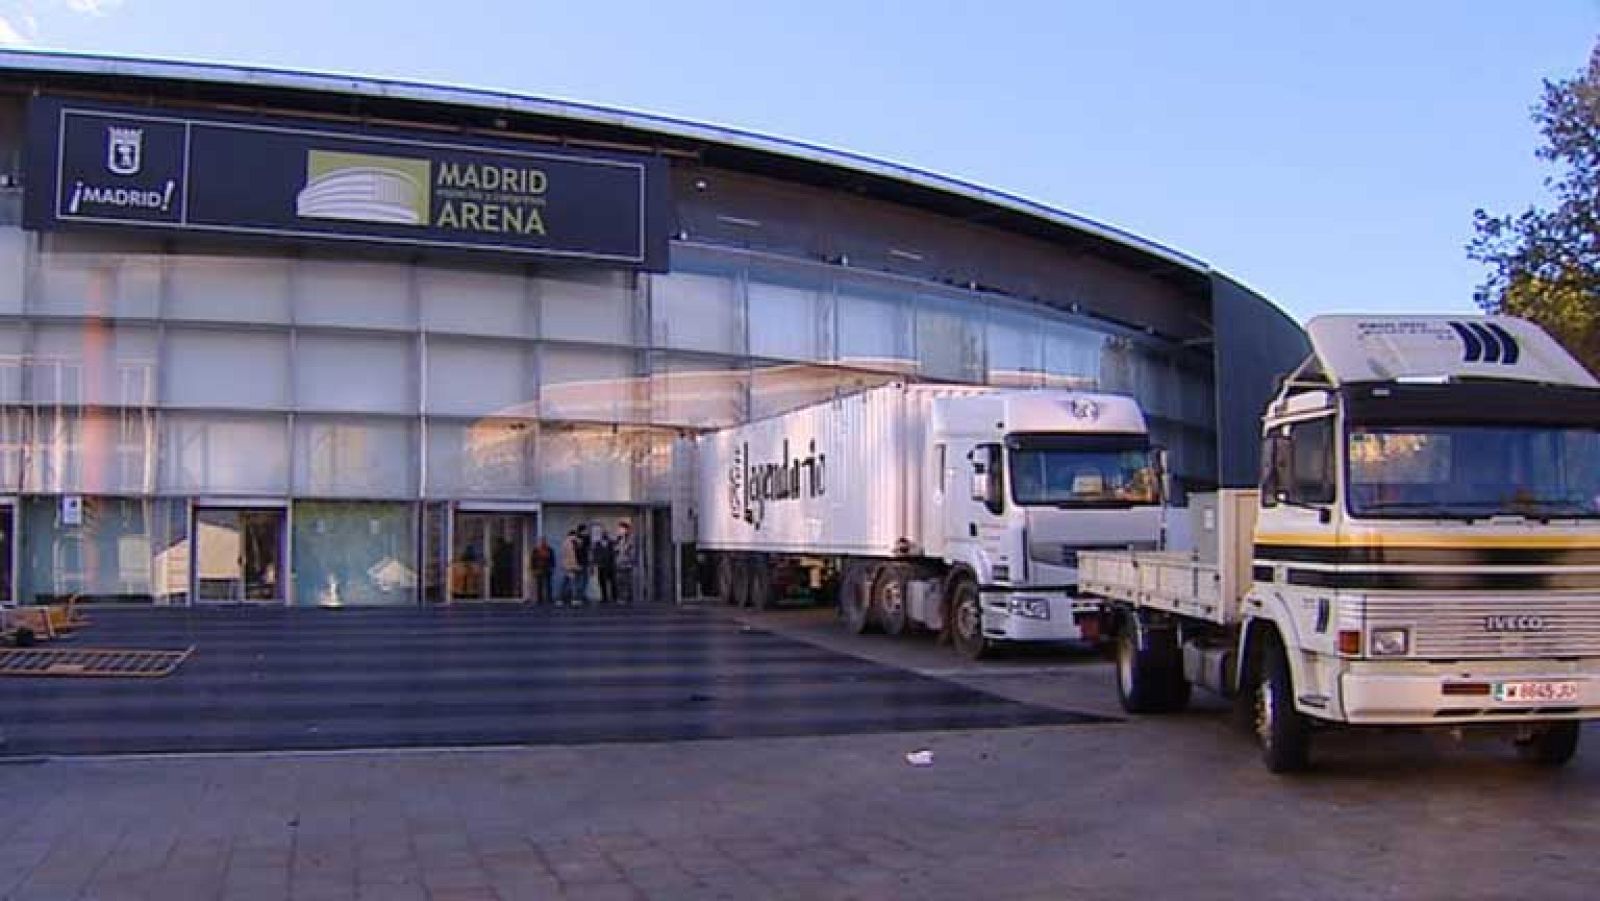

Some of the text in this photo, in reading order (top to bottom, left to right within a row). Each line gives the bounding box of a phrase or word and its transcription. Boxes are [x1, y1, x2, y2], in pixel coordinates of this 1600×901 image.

[437, 161, 548, 194] MADRID
[437, 200, 546, 235] ARENA
[1487, 615, 1543, 630] IVECO
